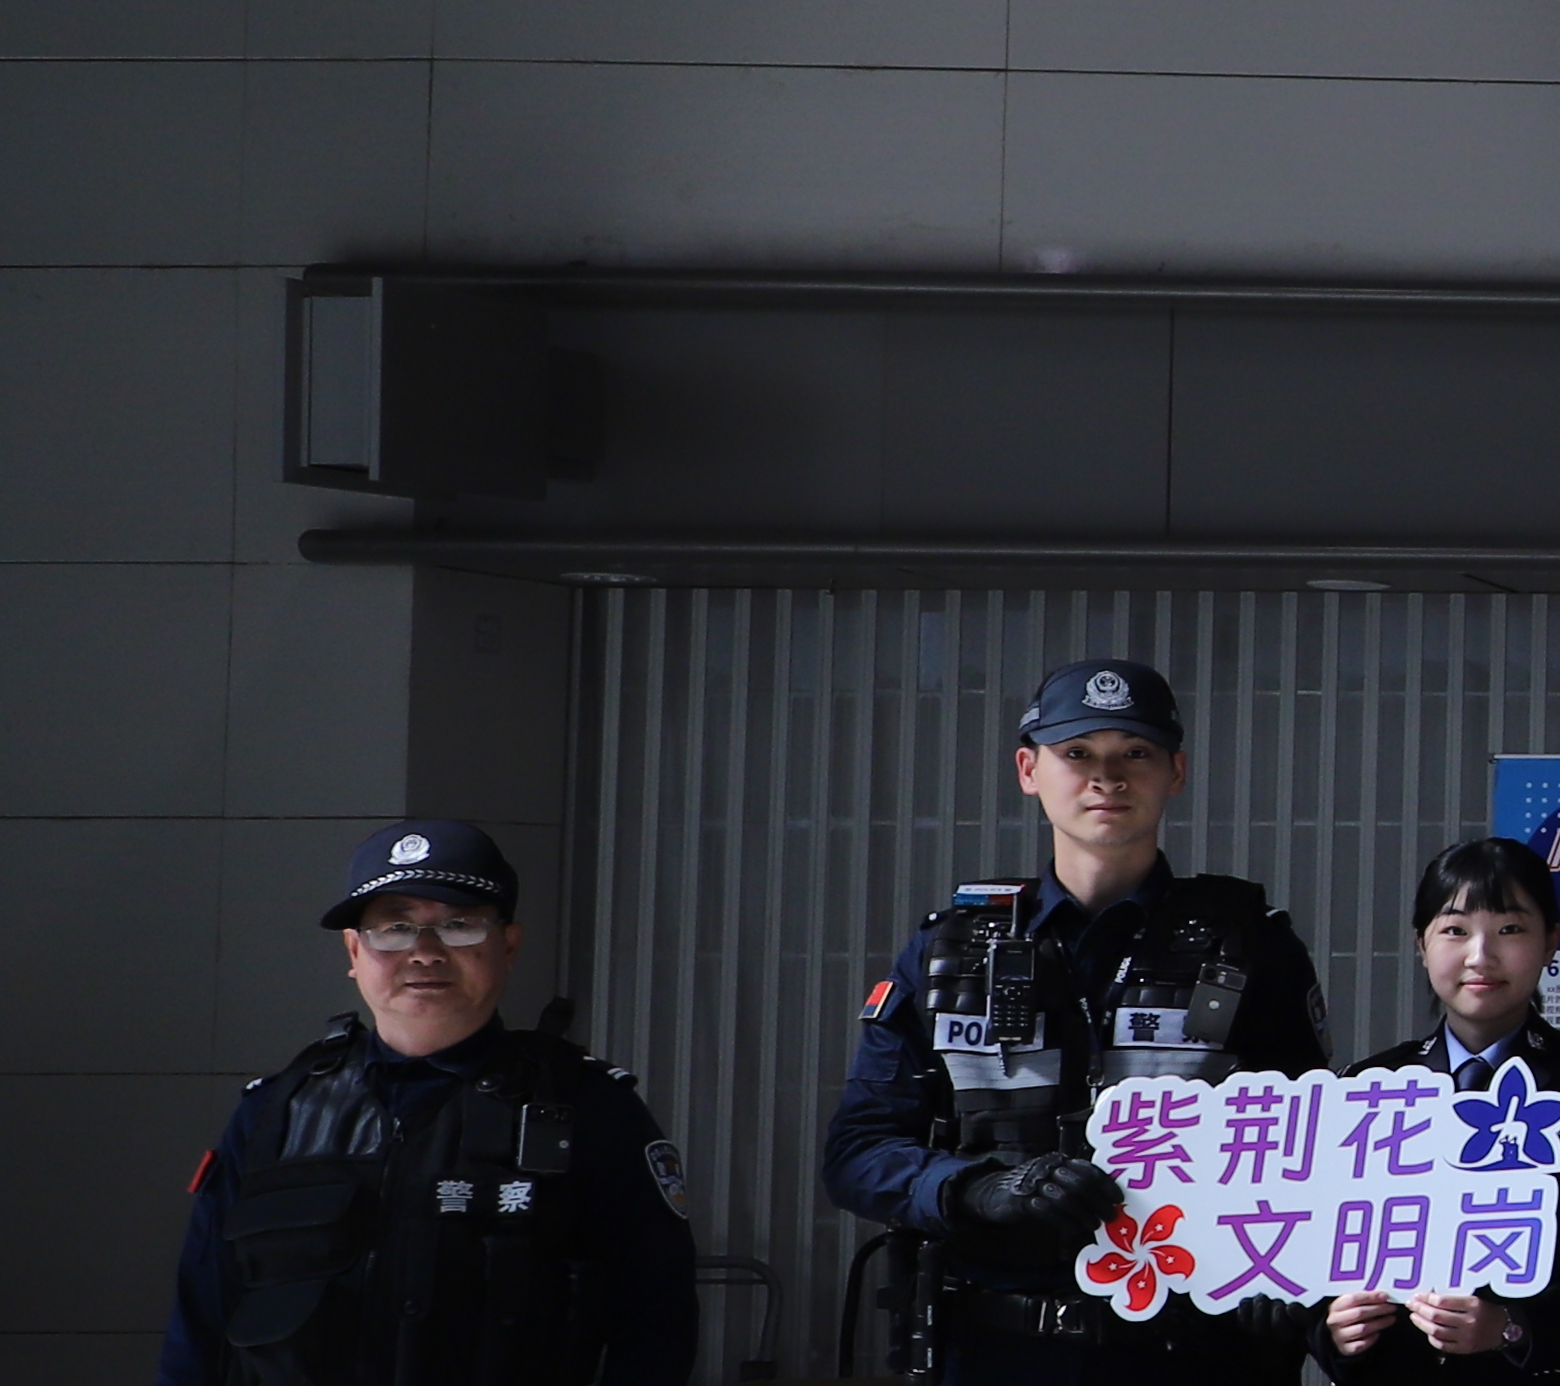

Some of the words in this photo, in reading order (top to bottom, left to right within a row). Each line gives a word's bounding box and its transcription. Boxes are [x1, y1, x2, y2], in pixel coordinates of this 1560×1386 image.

[1101, 1077, 1444, 1189] 紫荆花
[436, 1180, 532, 1213] 警察
[1206, 1186, 1547, 1302] 文明岗
